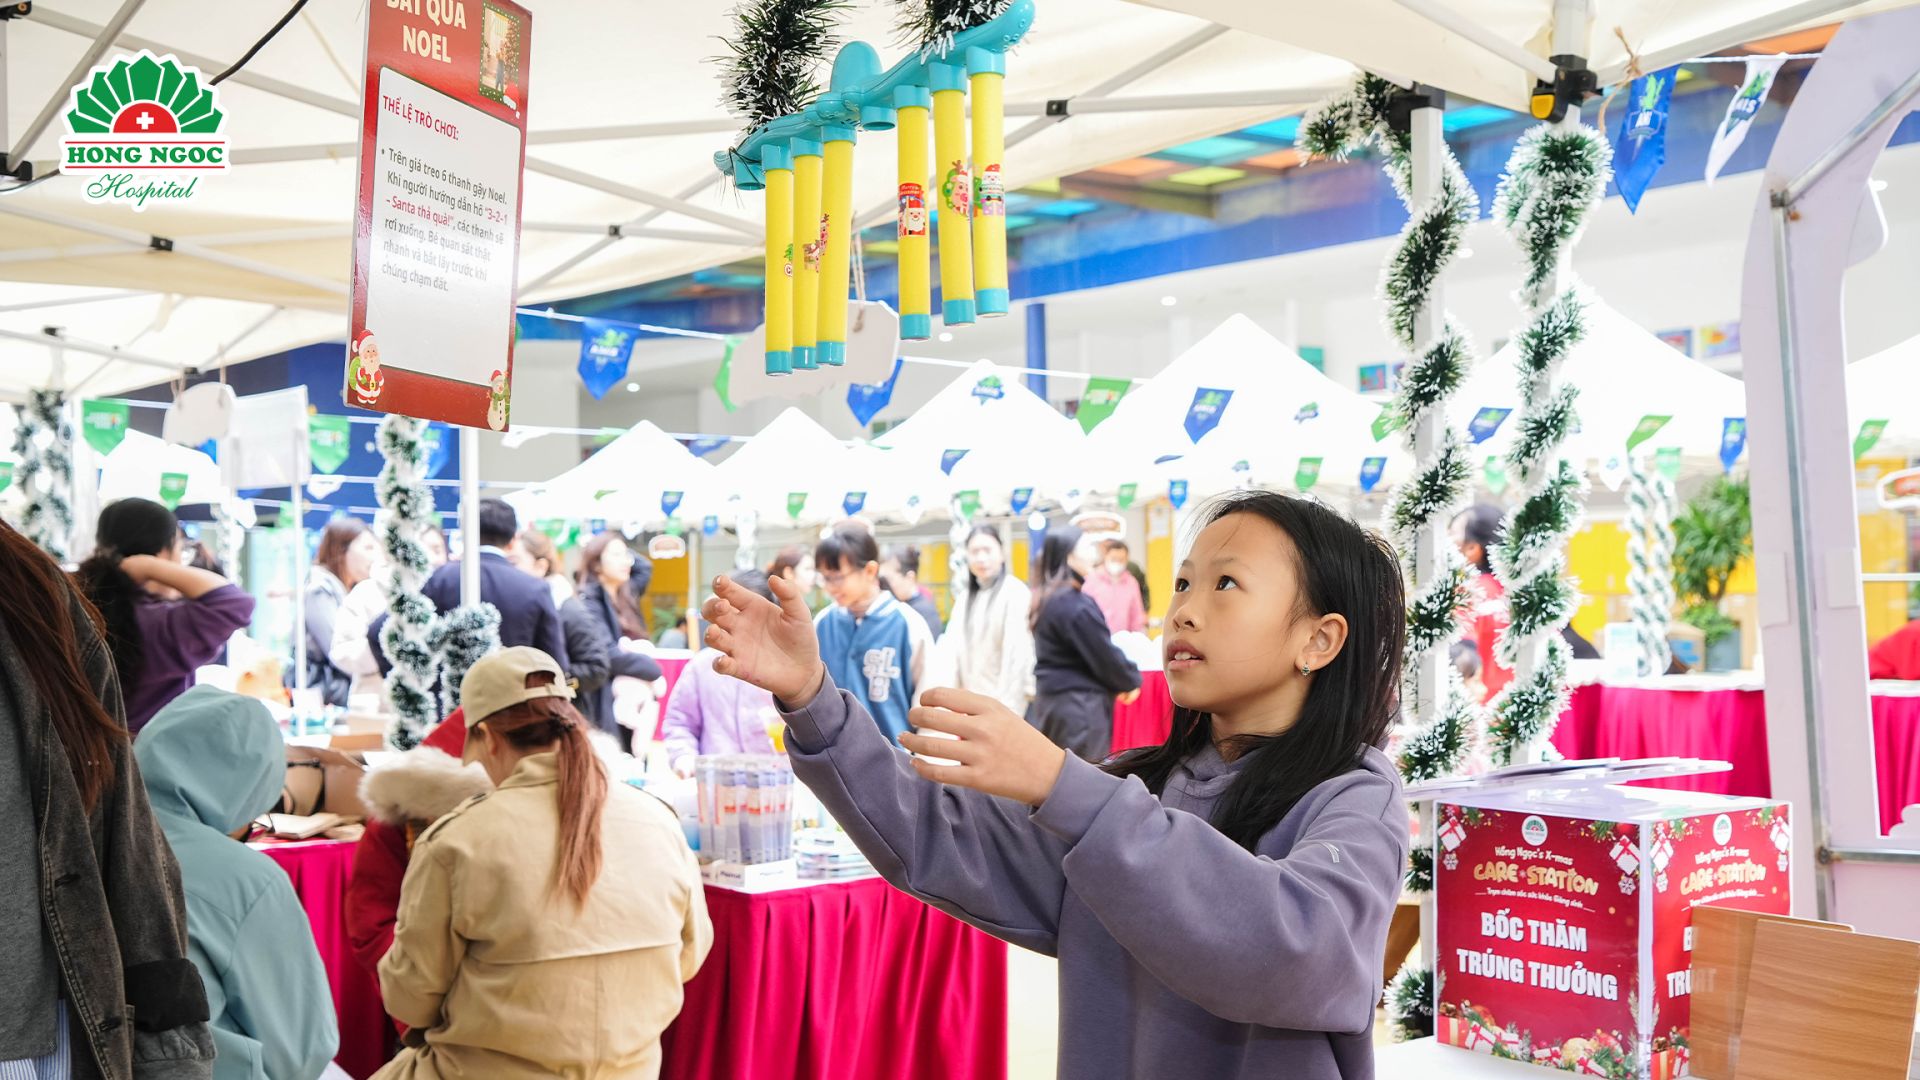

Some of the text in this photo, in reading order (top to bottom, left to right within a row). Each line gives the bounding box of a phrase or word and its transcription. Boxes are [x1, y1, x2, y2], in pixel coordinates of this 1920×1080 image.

[402, 25, 452, 63] NOEL
[382, 95, 459, 141] THỂ LỆ TRÒ CHƠI:
[387, 171, 401, 187] Khi
[402, 177, 428, 197] người
[429, 186, 456, 210] hướng
[457, 197, 472, 213] dẫn
[389, 148, 507, 205] Trên giá treo 6 thanh gậy Noel.
[384, 218, 397, 232] rơi
[428, 230, 438, 245] Bé
[392, 195, 416, 215] Santa
[418, 205, 431, 220] thả
[457, 219, 470, 233] các
[472, 223, 494, 241] thanh
[383, 240, 410, 258] nhanh
[1545, 850, 1574, 866] X-mas
[1680, 858, 1766, 895] CARE STATION
[1473, 861, 1600, 896] CARE STATION
[1481, 908, 1588, 952] BỐC THĂM
[1456, 948, 1618, 1001] TRÚNG THƯỞNG
